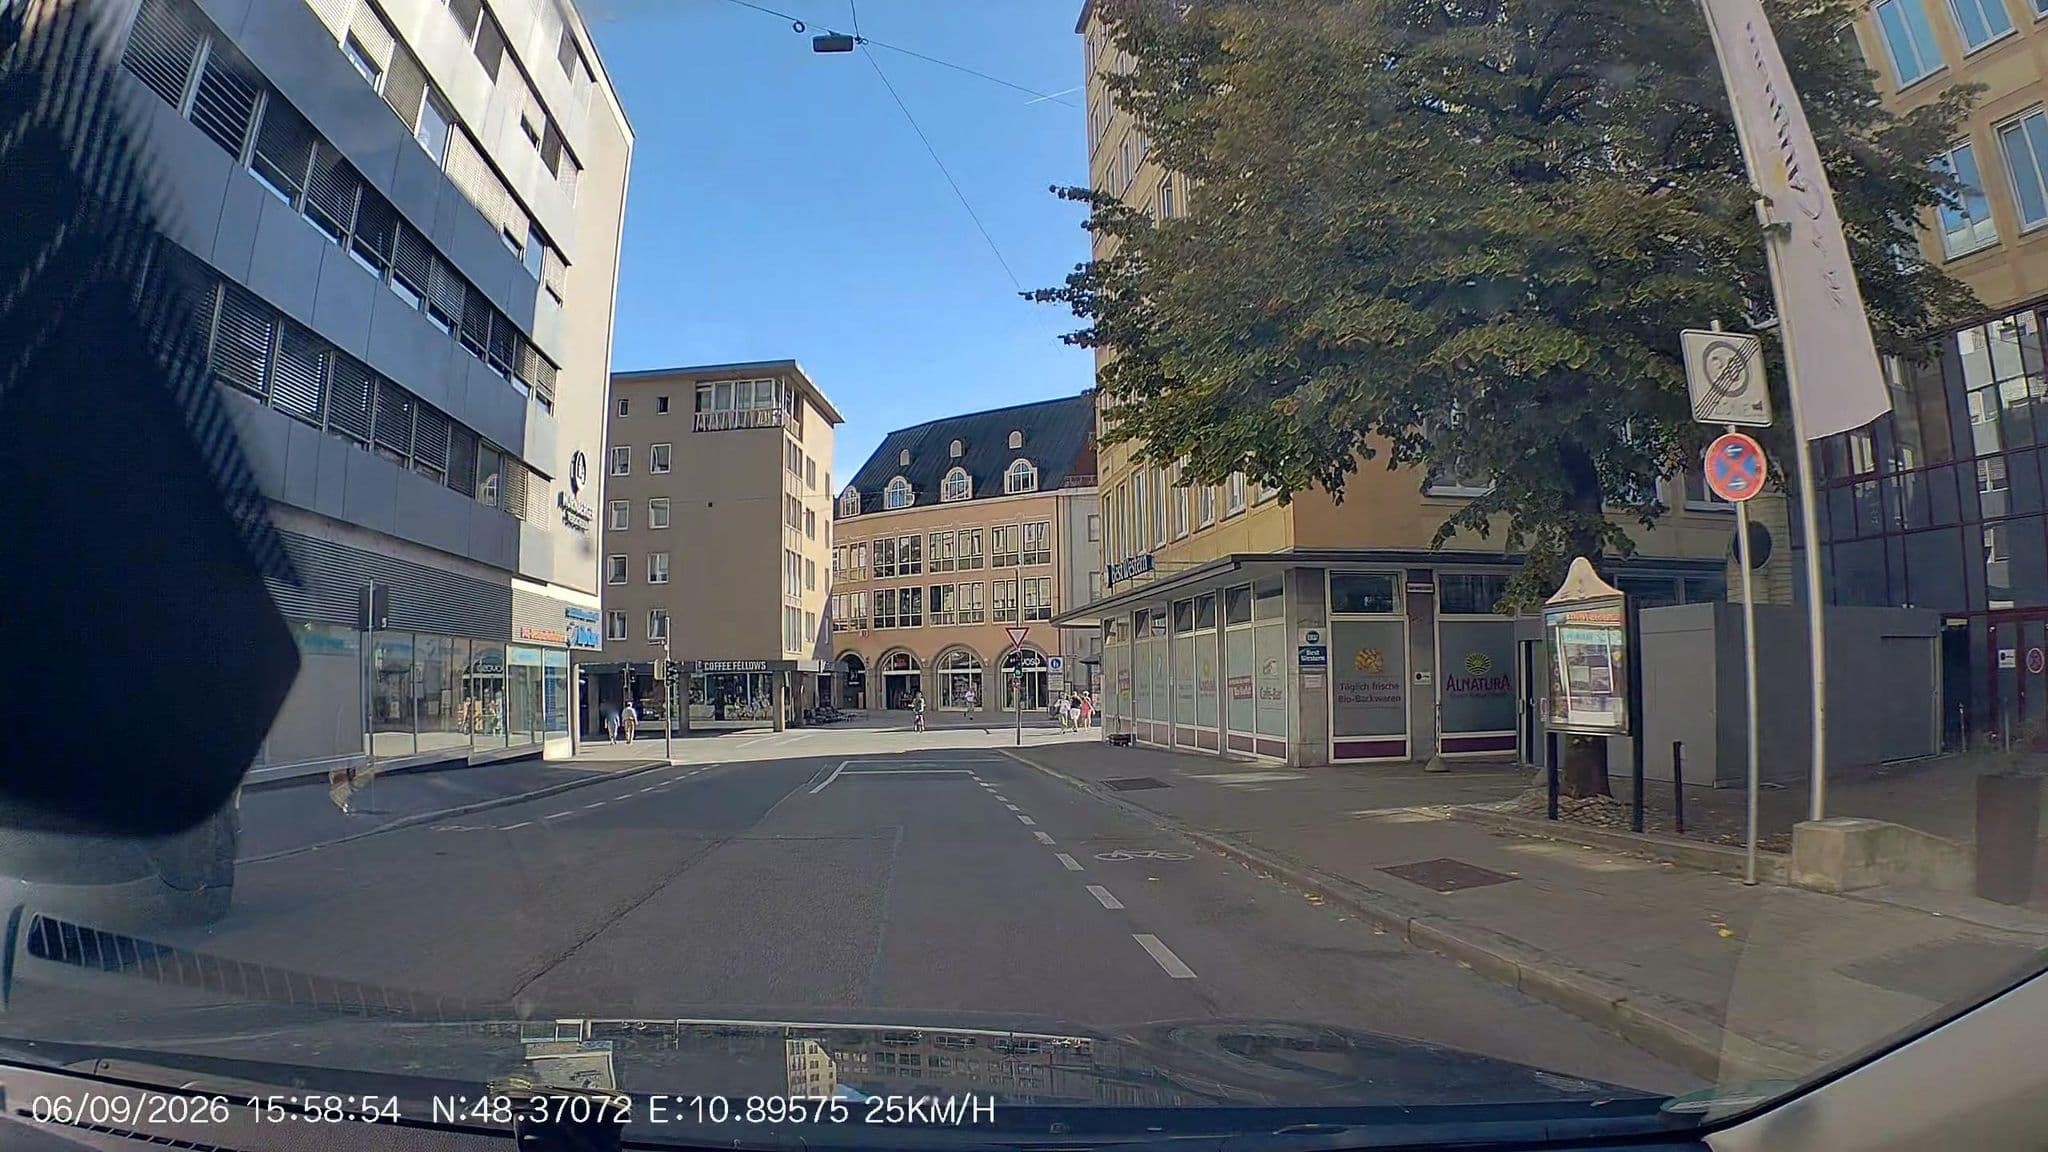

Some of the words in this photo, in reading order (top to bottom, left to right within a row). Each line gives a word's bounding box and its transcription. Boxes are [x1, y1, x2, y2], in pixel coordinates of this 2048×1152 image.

[704, 662, 732, 671] COFFEE
[733, 661, 767, 670] FELLOWS
[1446, 674, 1510, 691] ALNATURA
